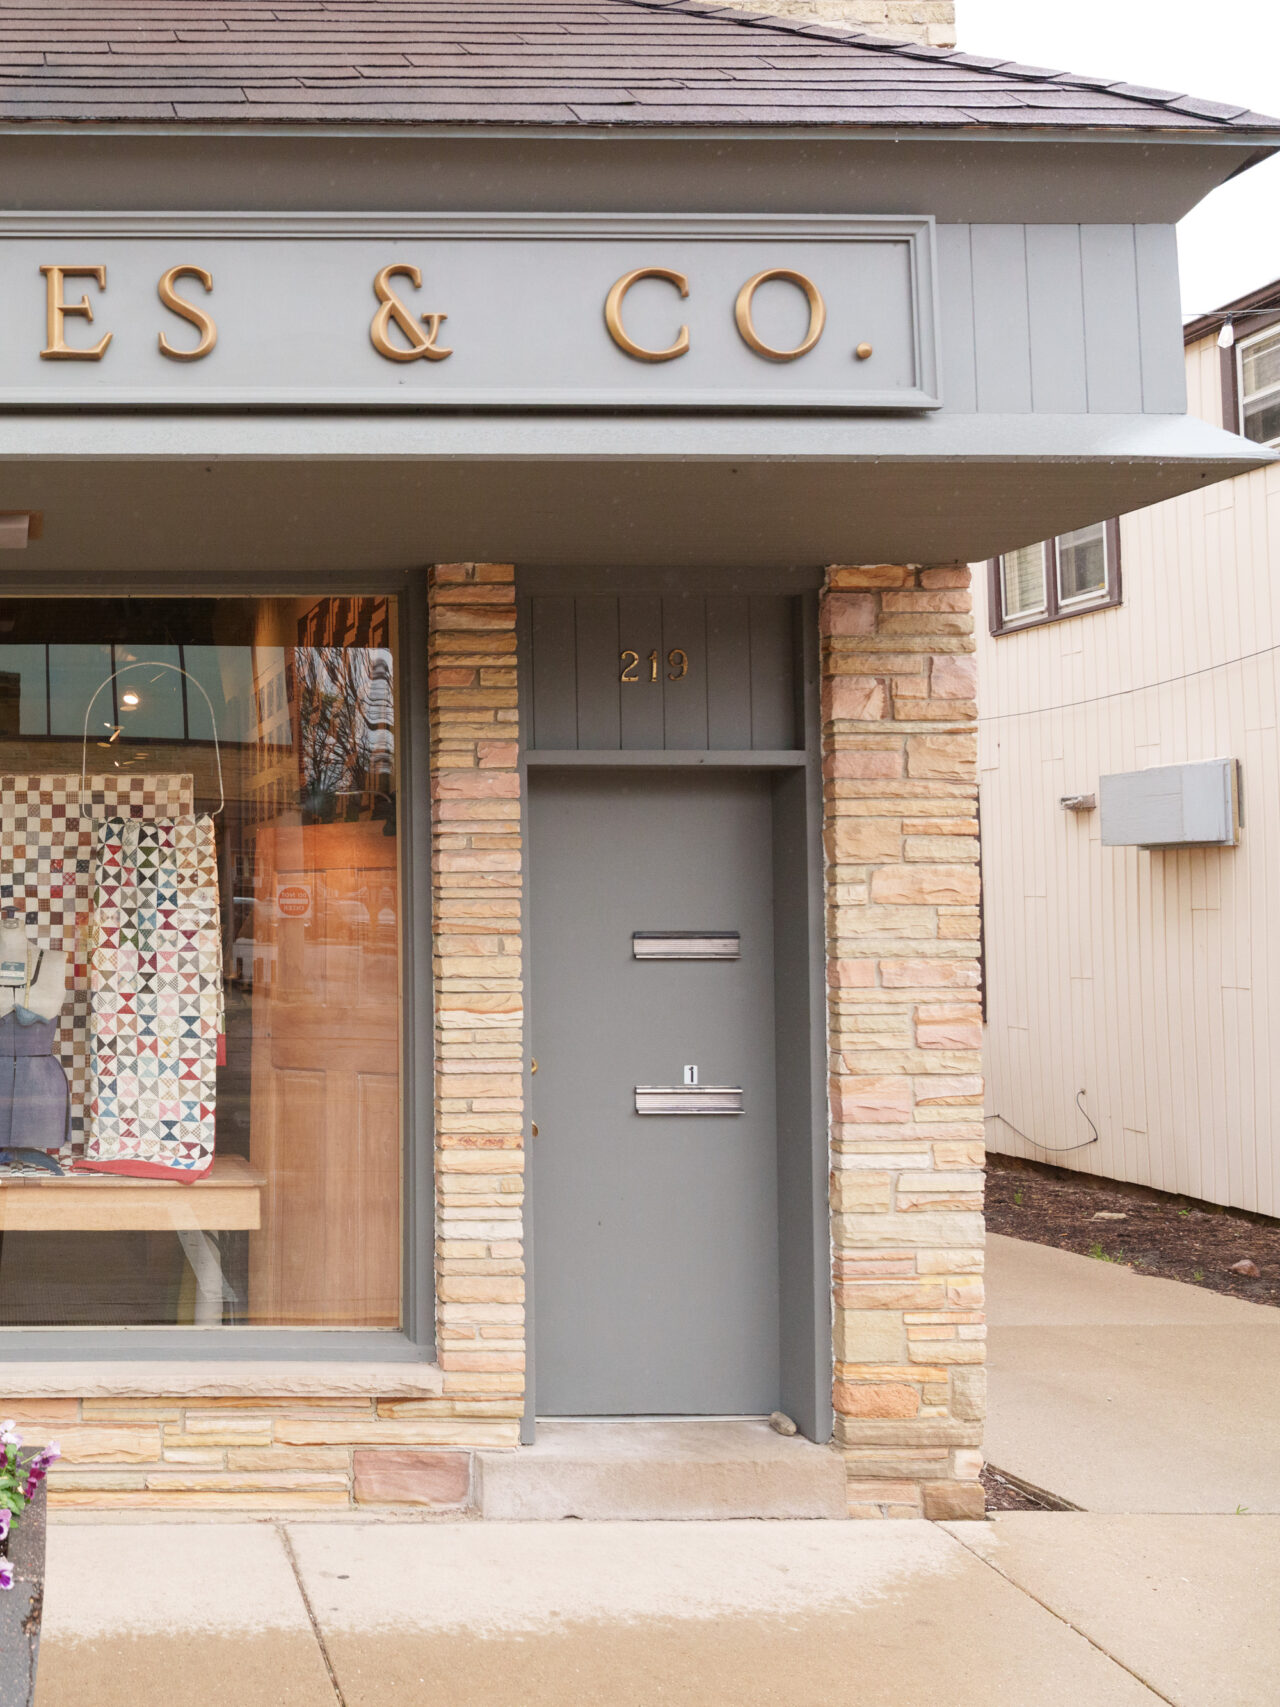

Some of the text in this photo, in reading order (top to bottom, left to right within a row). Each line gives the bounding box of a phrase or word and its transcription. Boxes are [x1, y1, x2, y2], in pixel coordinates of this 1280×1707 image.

[370, 262, 453, 362] &
[605, 266, 873, 364] CO.
[620, 648, 689, 682] 219
[688, 1065, 695, 1083] 1
